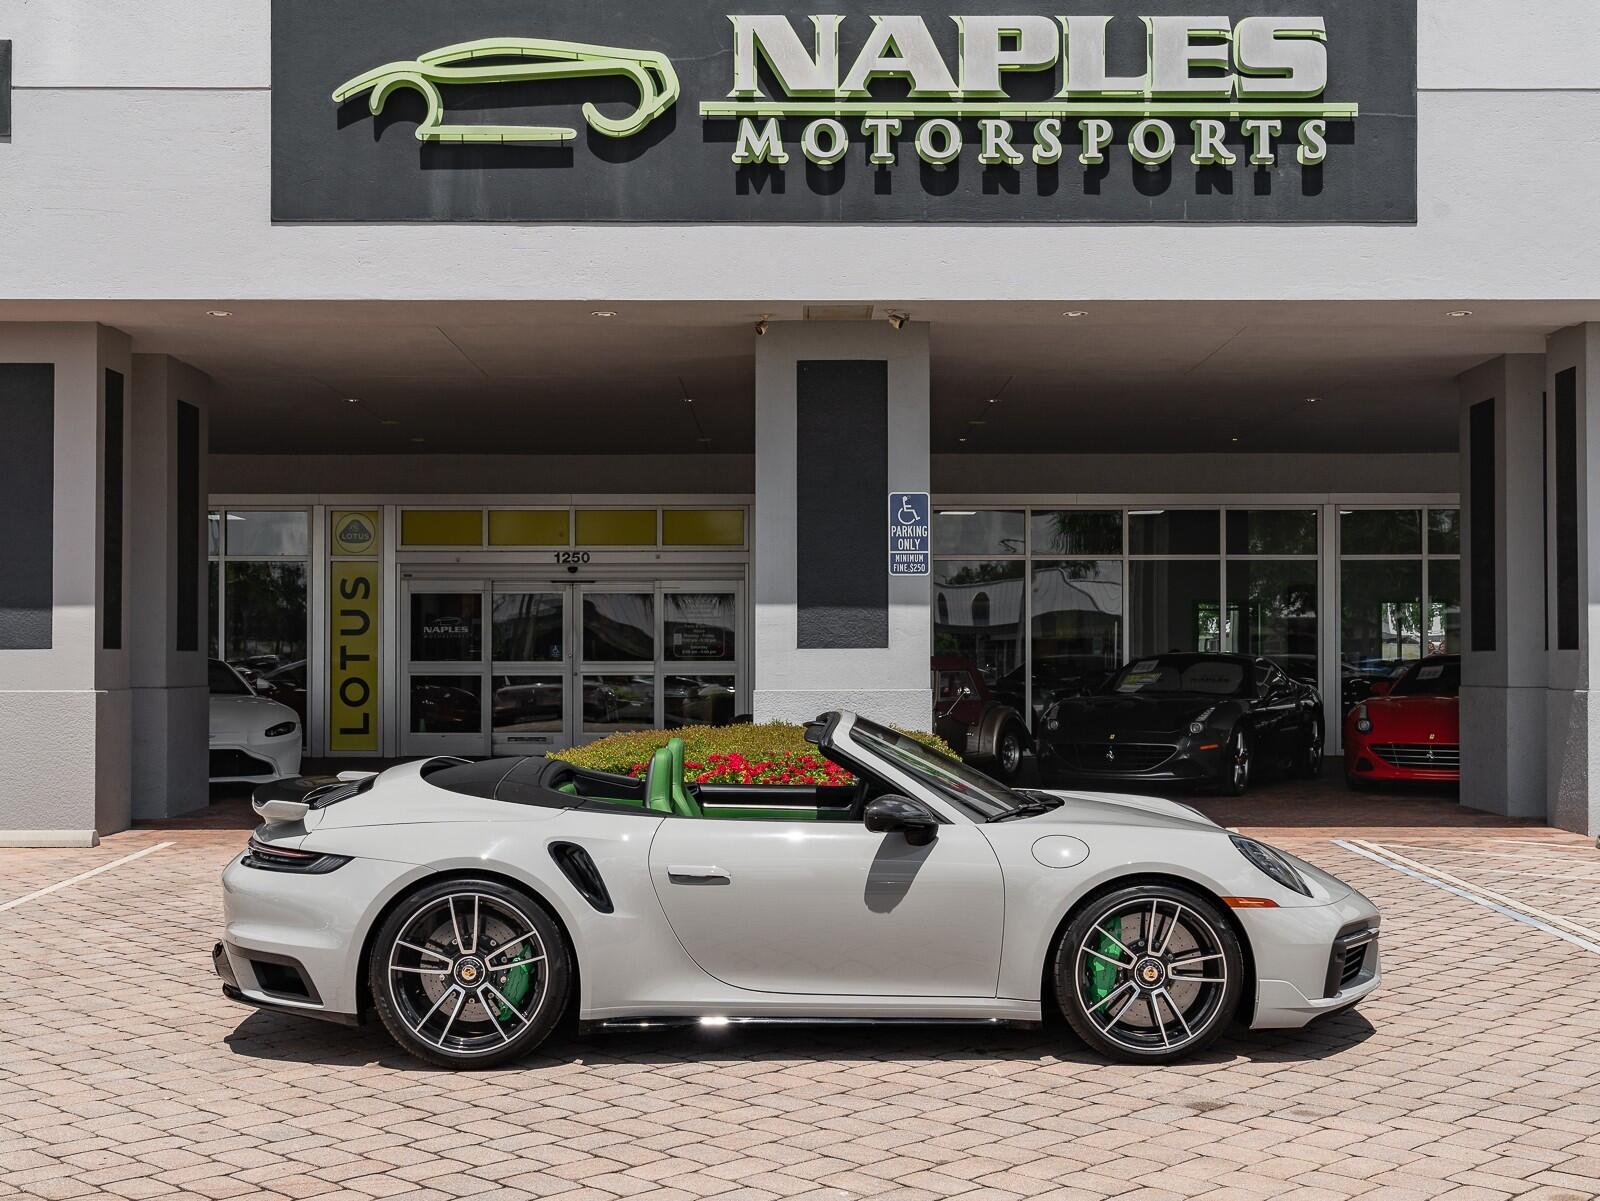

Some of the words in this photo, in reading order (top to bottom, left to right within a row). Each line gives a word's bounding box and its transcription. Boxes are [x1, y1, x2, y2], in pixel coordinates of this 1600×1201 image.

[727, 15, 1328, 99] NAPLES
[732, 118, 1327, 165] MOTORSPORTS
[341, 532, 370, 540] LOTUS
[891, 525, 927, 537] PARKING
[898, 539, 921, 550] ONLY
[554, 551, 591, 563] 1250
[895, 554, 924, 562] MINIMUM
[339, 576, 370, 735] LOTUS
